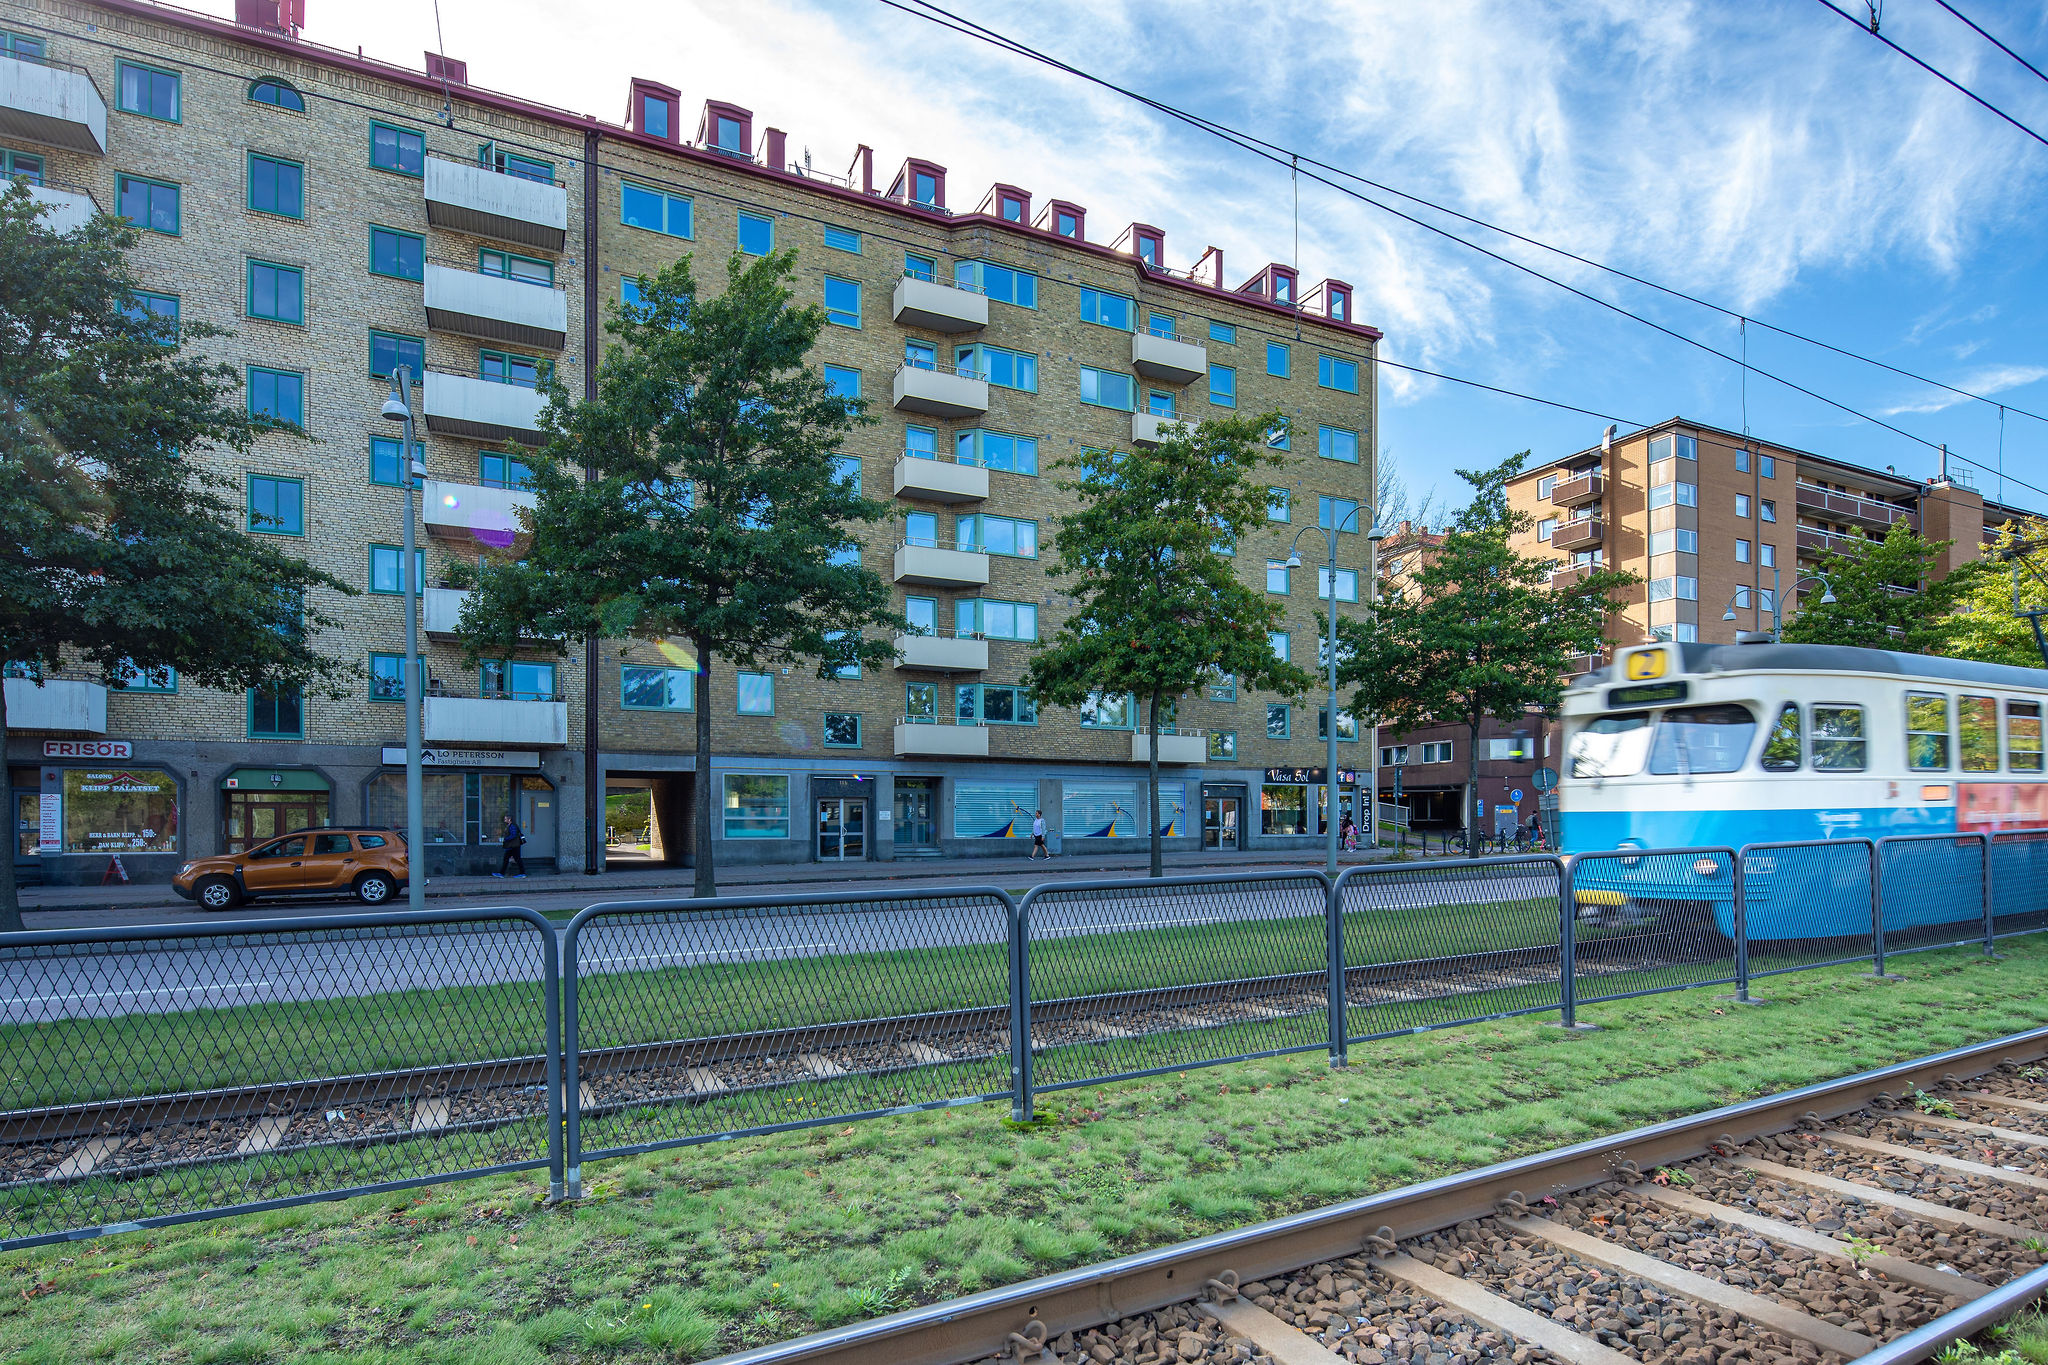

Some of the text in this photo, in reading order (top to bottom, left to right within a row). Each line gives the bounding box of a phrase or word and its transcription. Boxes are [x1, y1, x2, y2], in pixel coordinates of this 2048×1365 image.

[1638, 652, 1656, 676] 2
[45, 742, 128, 757] FRISÖR
[452, 751, 505, 759] PETERSSON
[1294, 769, 1310, 782] Sol
[1362, 808, 1371, 832] Drop
